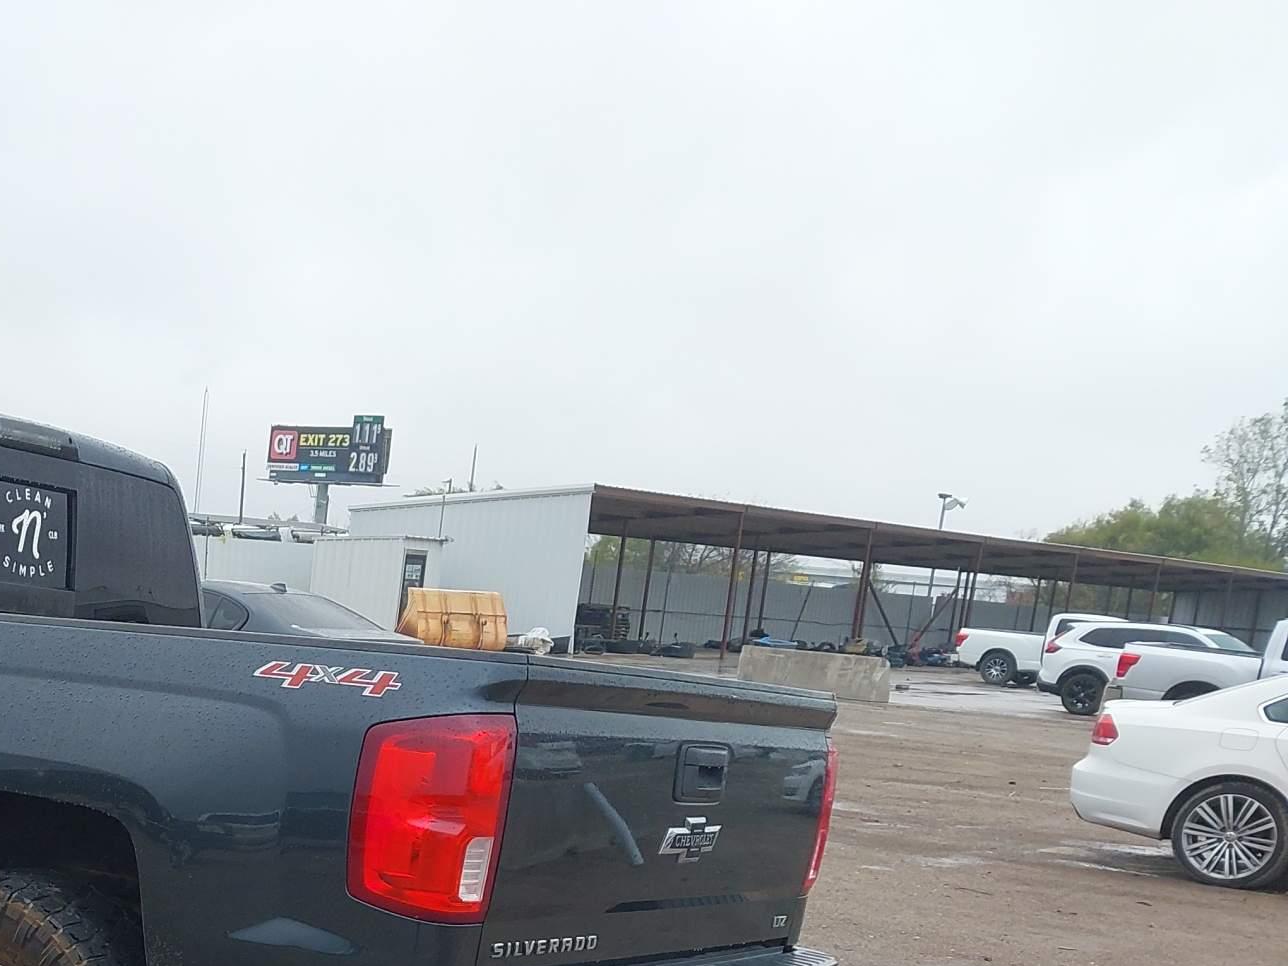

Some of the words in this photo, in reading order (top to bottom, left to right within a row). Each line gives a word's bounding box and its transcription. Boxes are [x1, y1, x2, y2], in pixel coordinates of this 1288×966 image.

[274, 434, 294, 454] QT
[299, 434, 326, 446] EXIT
[327, 434, 350, 447] 273
[6, 488, 52, 509] CLEAN
[3, 556, 54, 577] SIMPLE
[492, 935, 597, 958] SILVERADO
